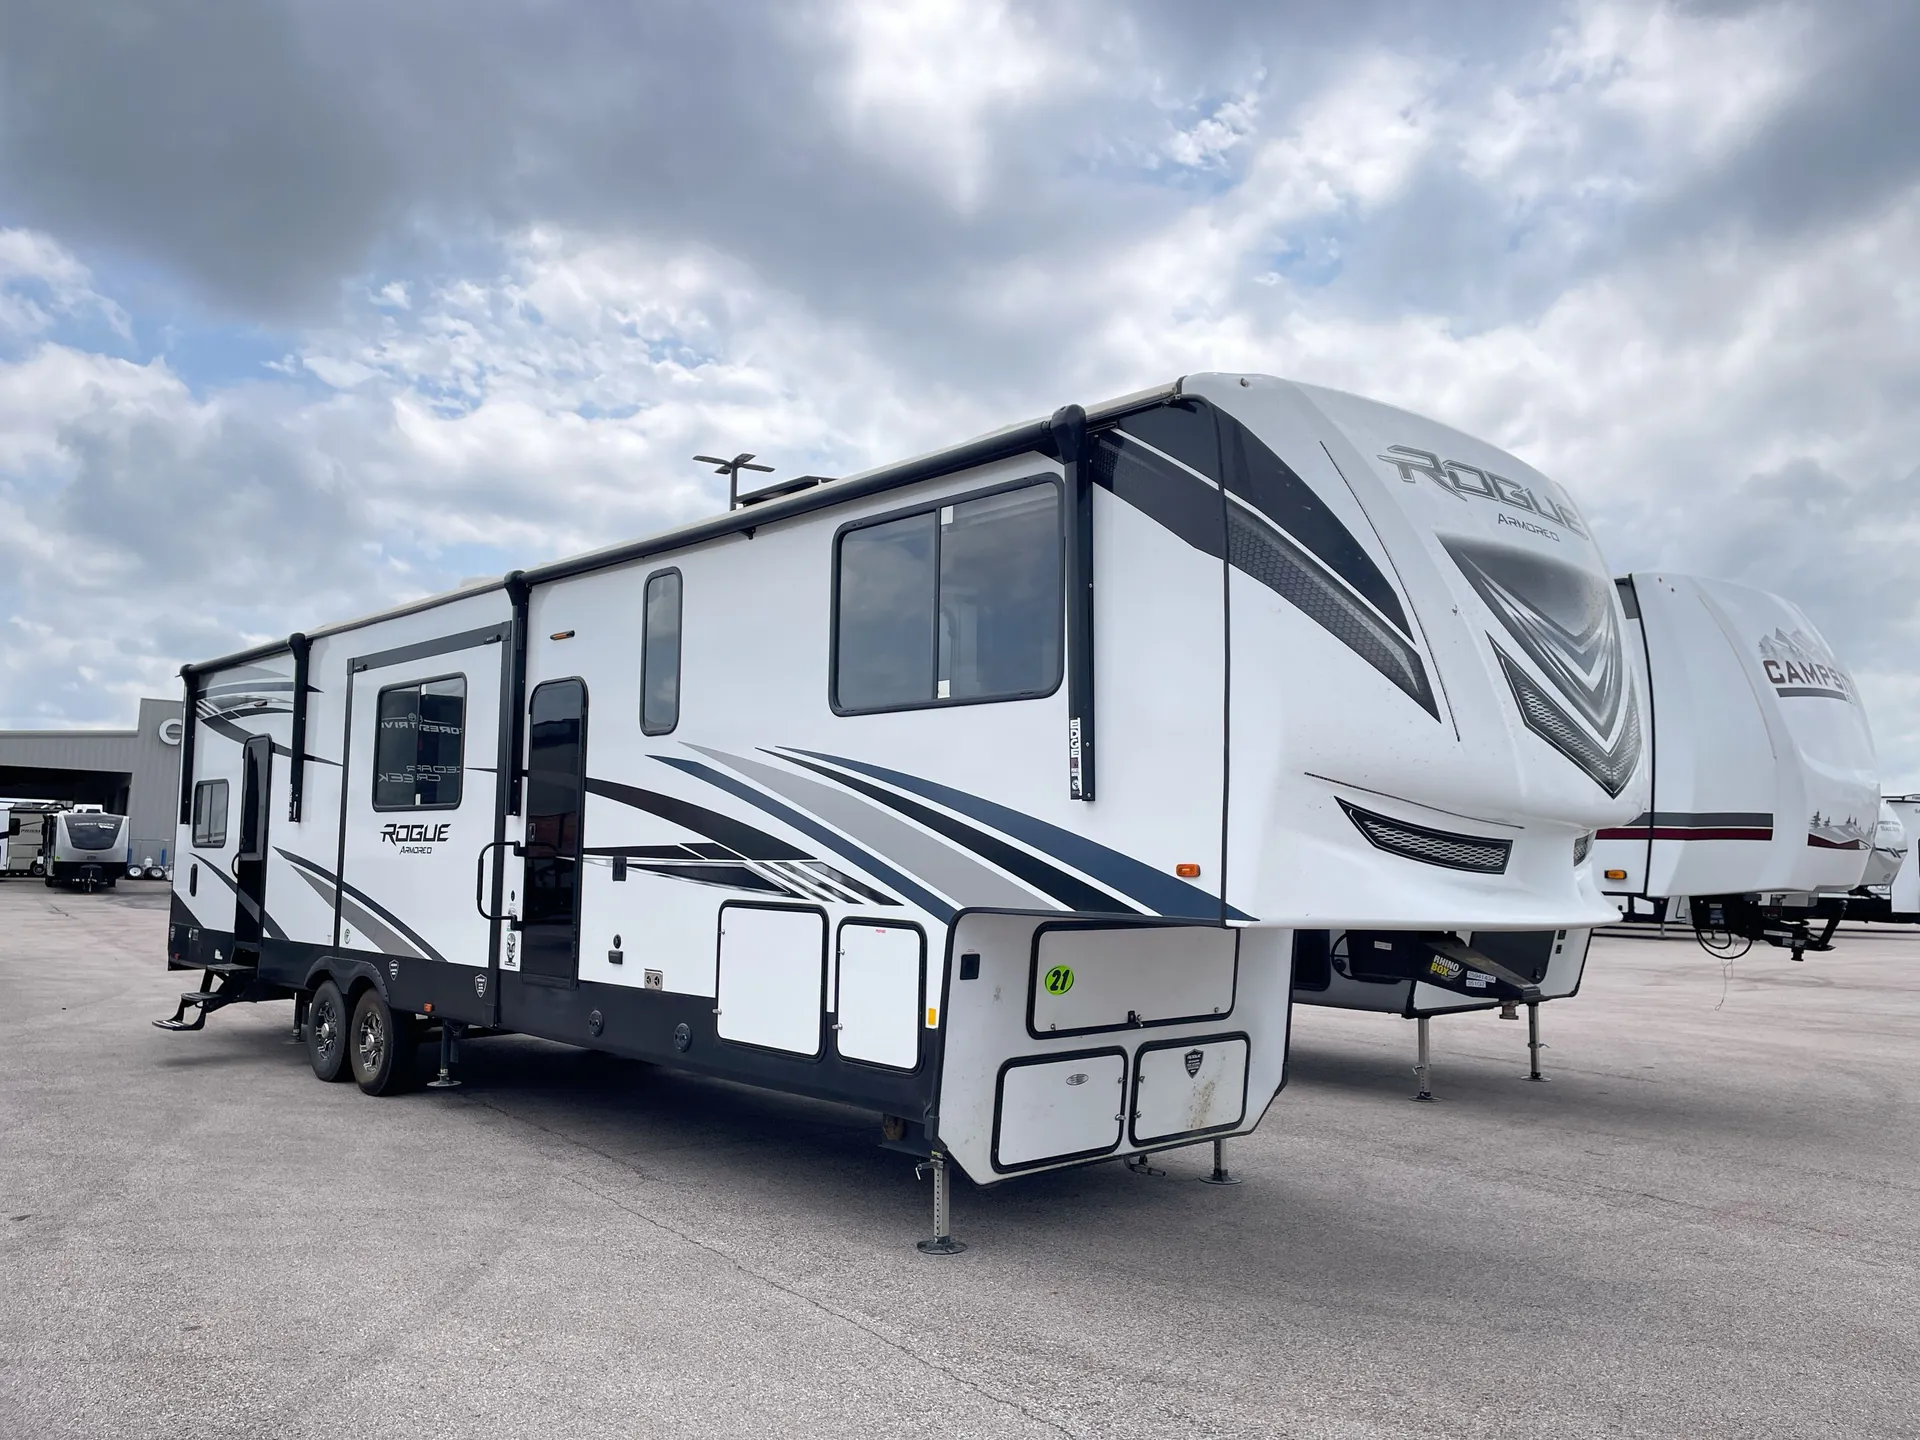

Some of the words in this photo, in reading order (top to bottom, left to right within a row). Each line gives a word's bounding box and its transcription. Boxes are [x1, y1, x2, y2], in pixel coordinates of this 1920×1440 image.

[1377, 445, 1589, 540] ROGUE
[1498, 513, 1560, 542] ARMORED
[380, 824, 451, 846] ROGUE
[399, 846, 432, 854] ARMORED
[1430, 962, 1449, 977] BOX
[1433, 954, 1460, 972] RHINO
[1050, 969, 1070, 991] 21
